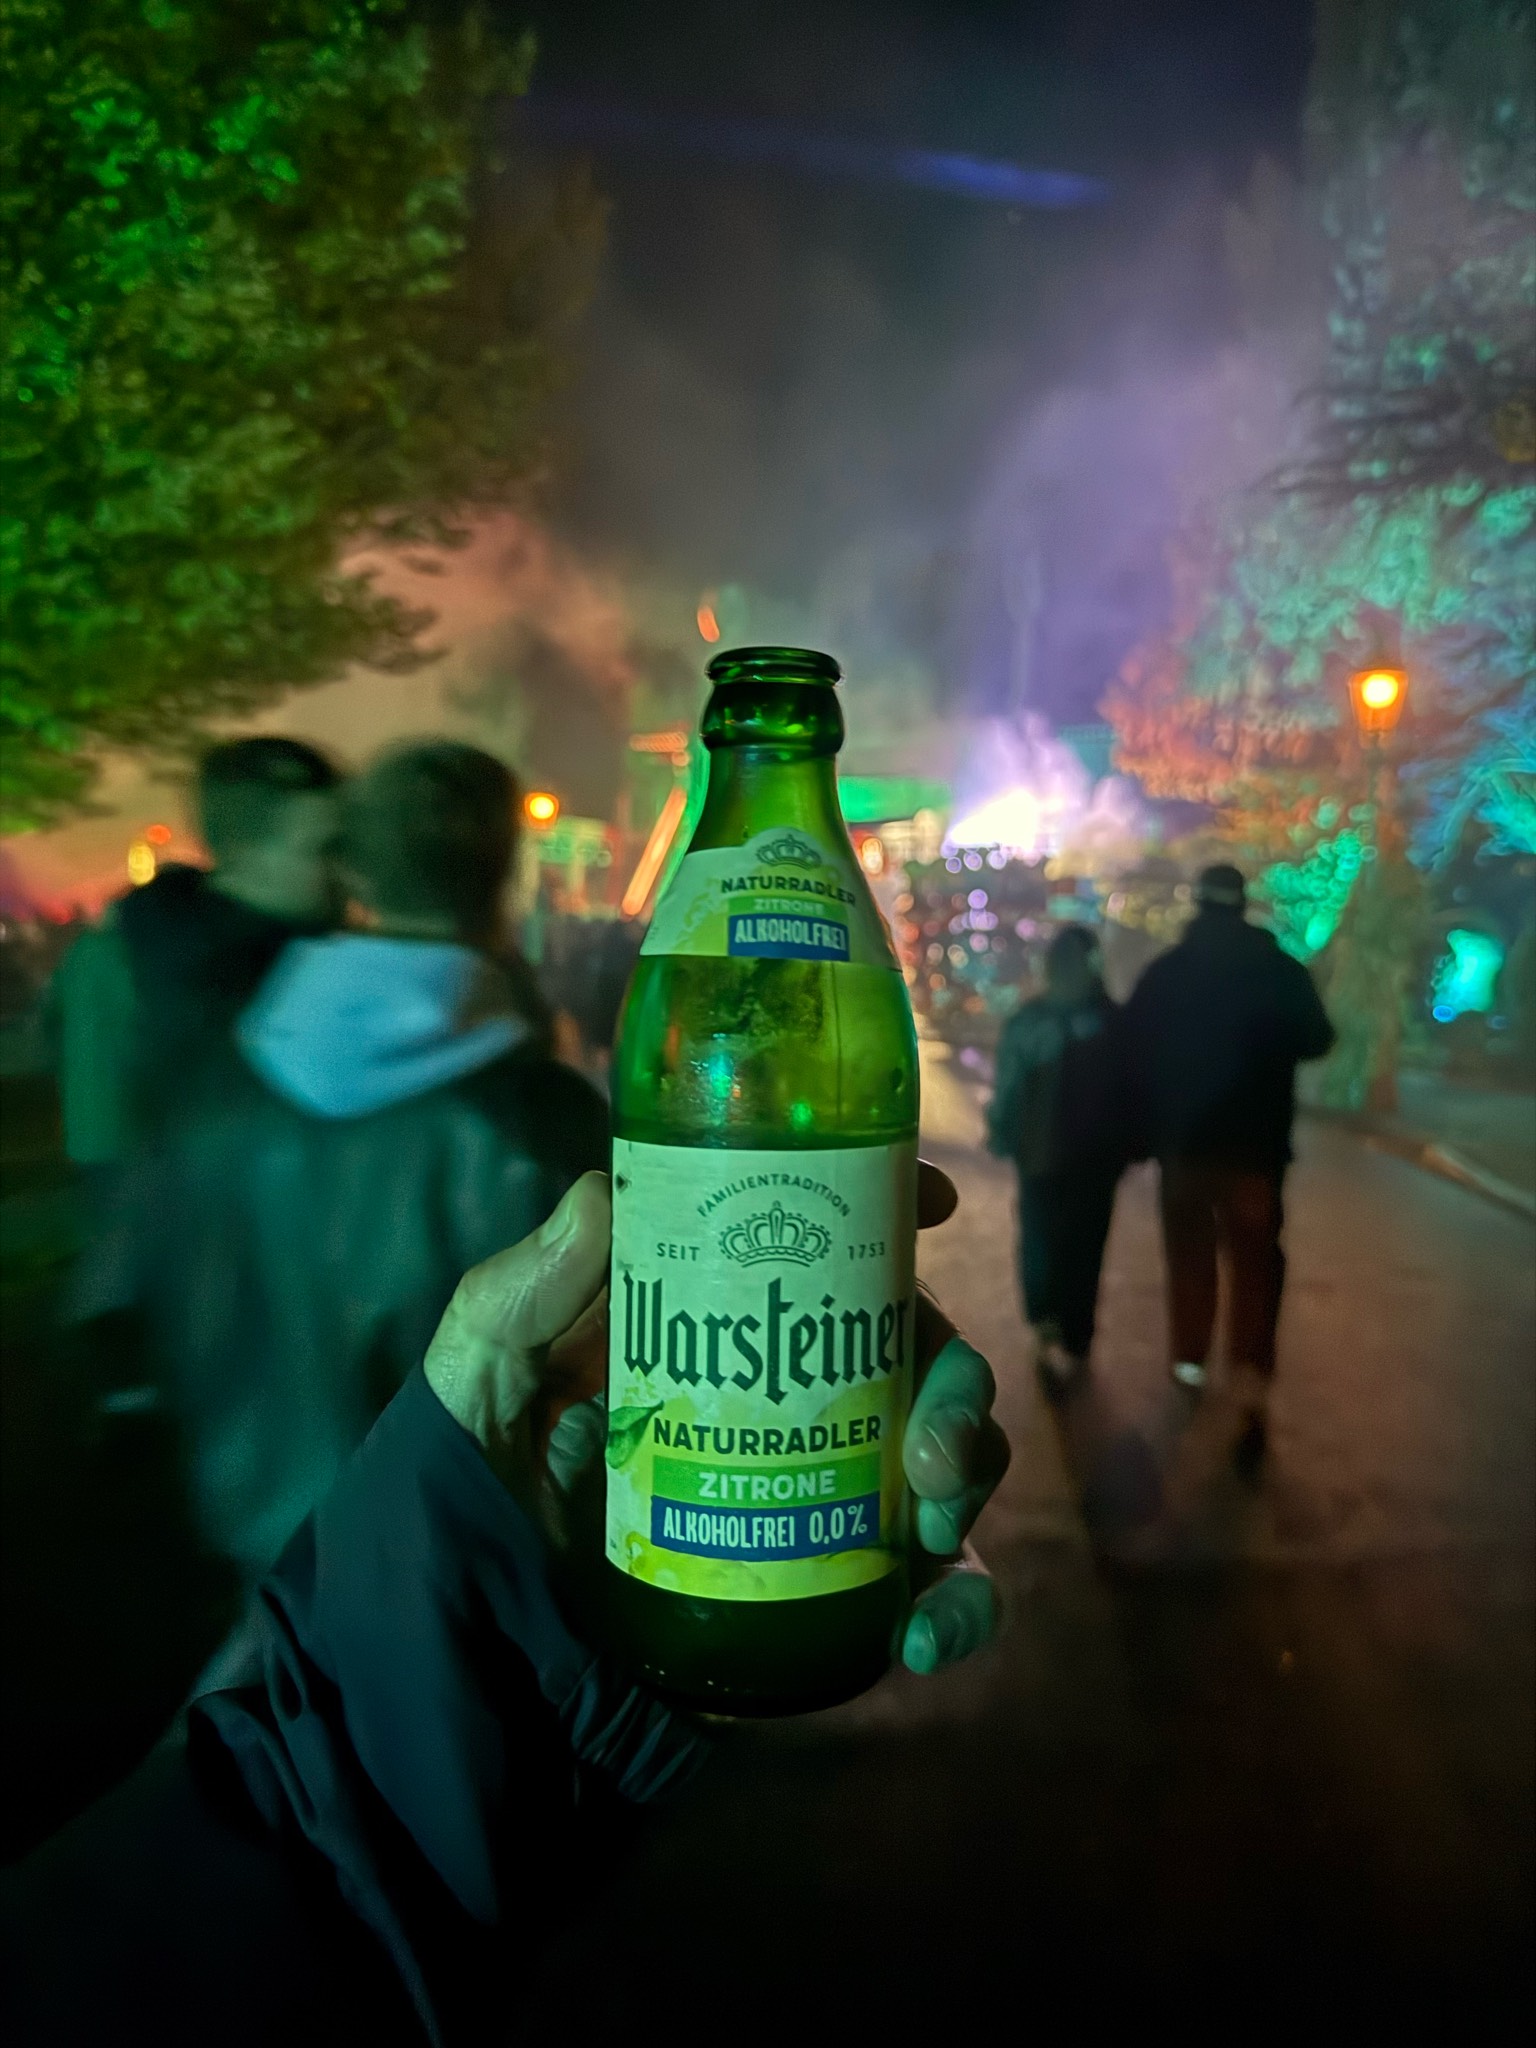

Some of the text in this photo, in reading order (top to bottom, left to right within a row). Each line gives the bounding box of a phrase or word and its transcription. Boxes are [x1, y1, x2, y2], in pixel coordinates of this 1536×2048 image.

[721, 876, 856, 906] NATURRADLER
[735, 918, 847, 951] ALKOHOLFREI
[697, 1173, 851, 1218] FAMILIENTRADITION
[656, 1242, 886, 1262] SEIT 1753
[623, 1270, 908, 1405] Warsteiner
[653, 1415, 881, 1456] NATURRADLER
[699, 1469, 837, 1500] ZITRONE
[663, 1503, 868, 1549] ALKOHOLFREI 0,0%
